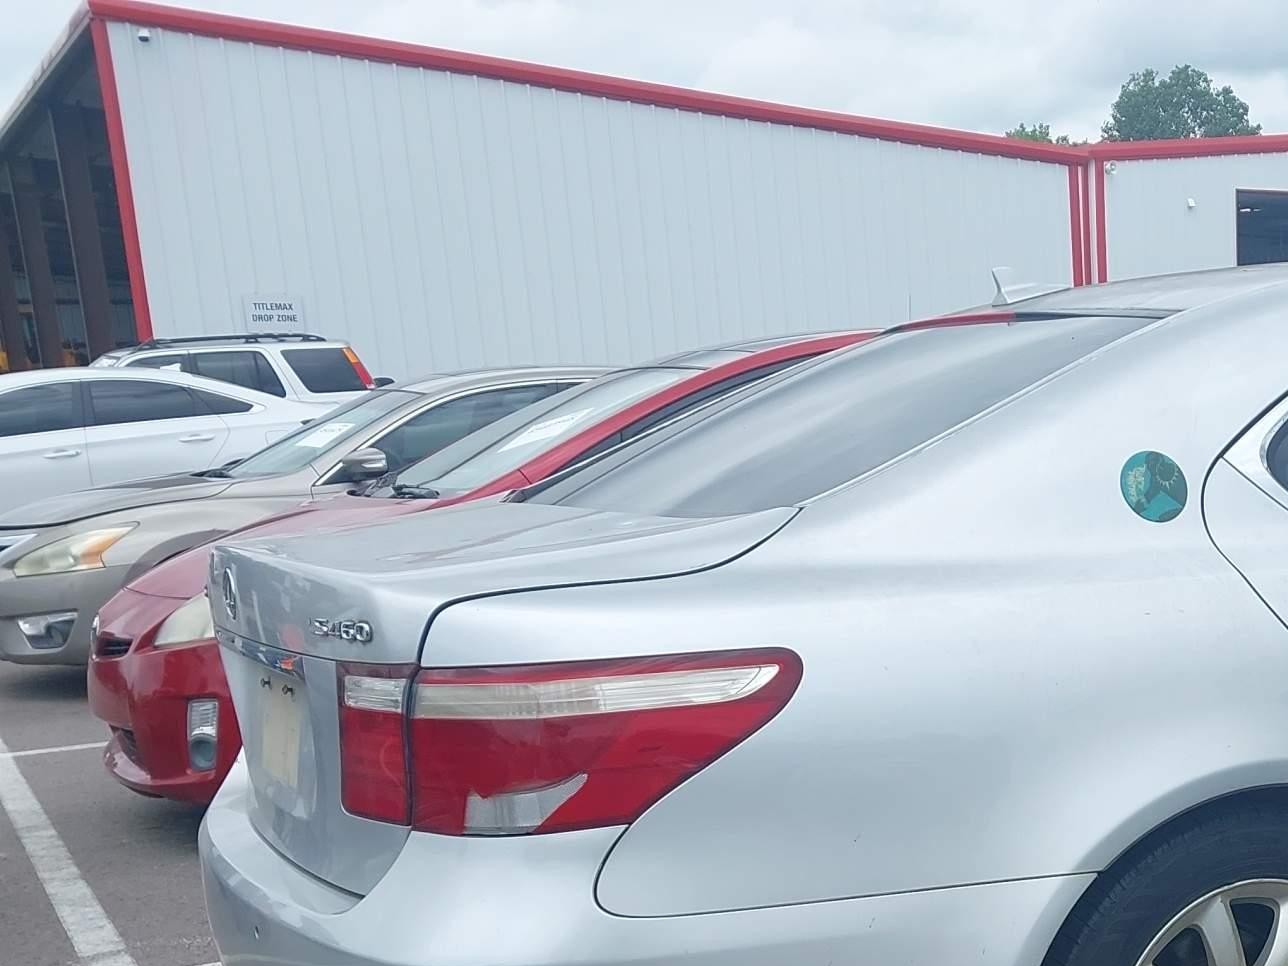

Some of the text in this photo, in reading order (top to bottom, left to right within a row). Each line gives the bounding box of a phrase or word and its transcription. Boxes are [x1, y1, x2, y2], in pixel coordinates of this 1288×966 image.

[252, 302, 294, 311] TITLEMAX
[251, 314, 298, 322] DROP ZONE
[306, 616, 374, 644] S460
